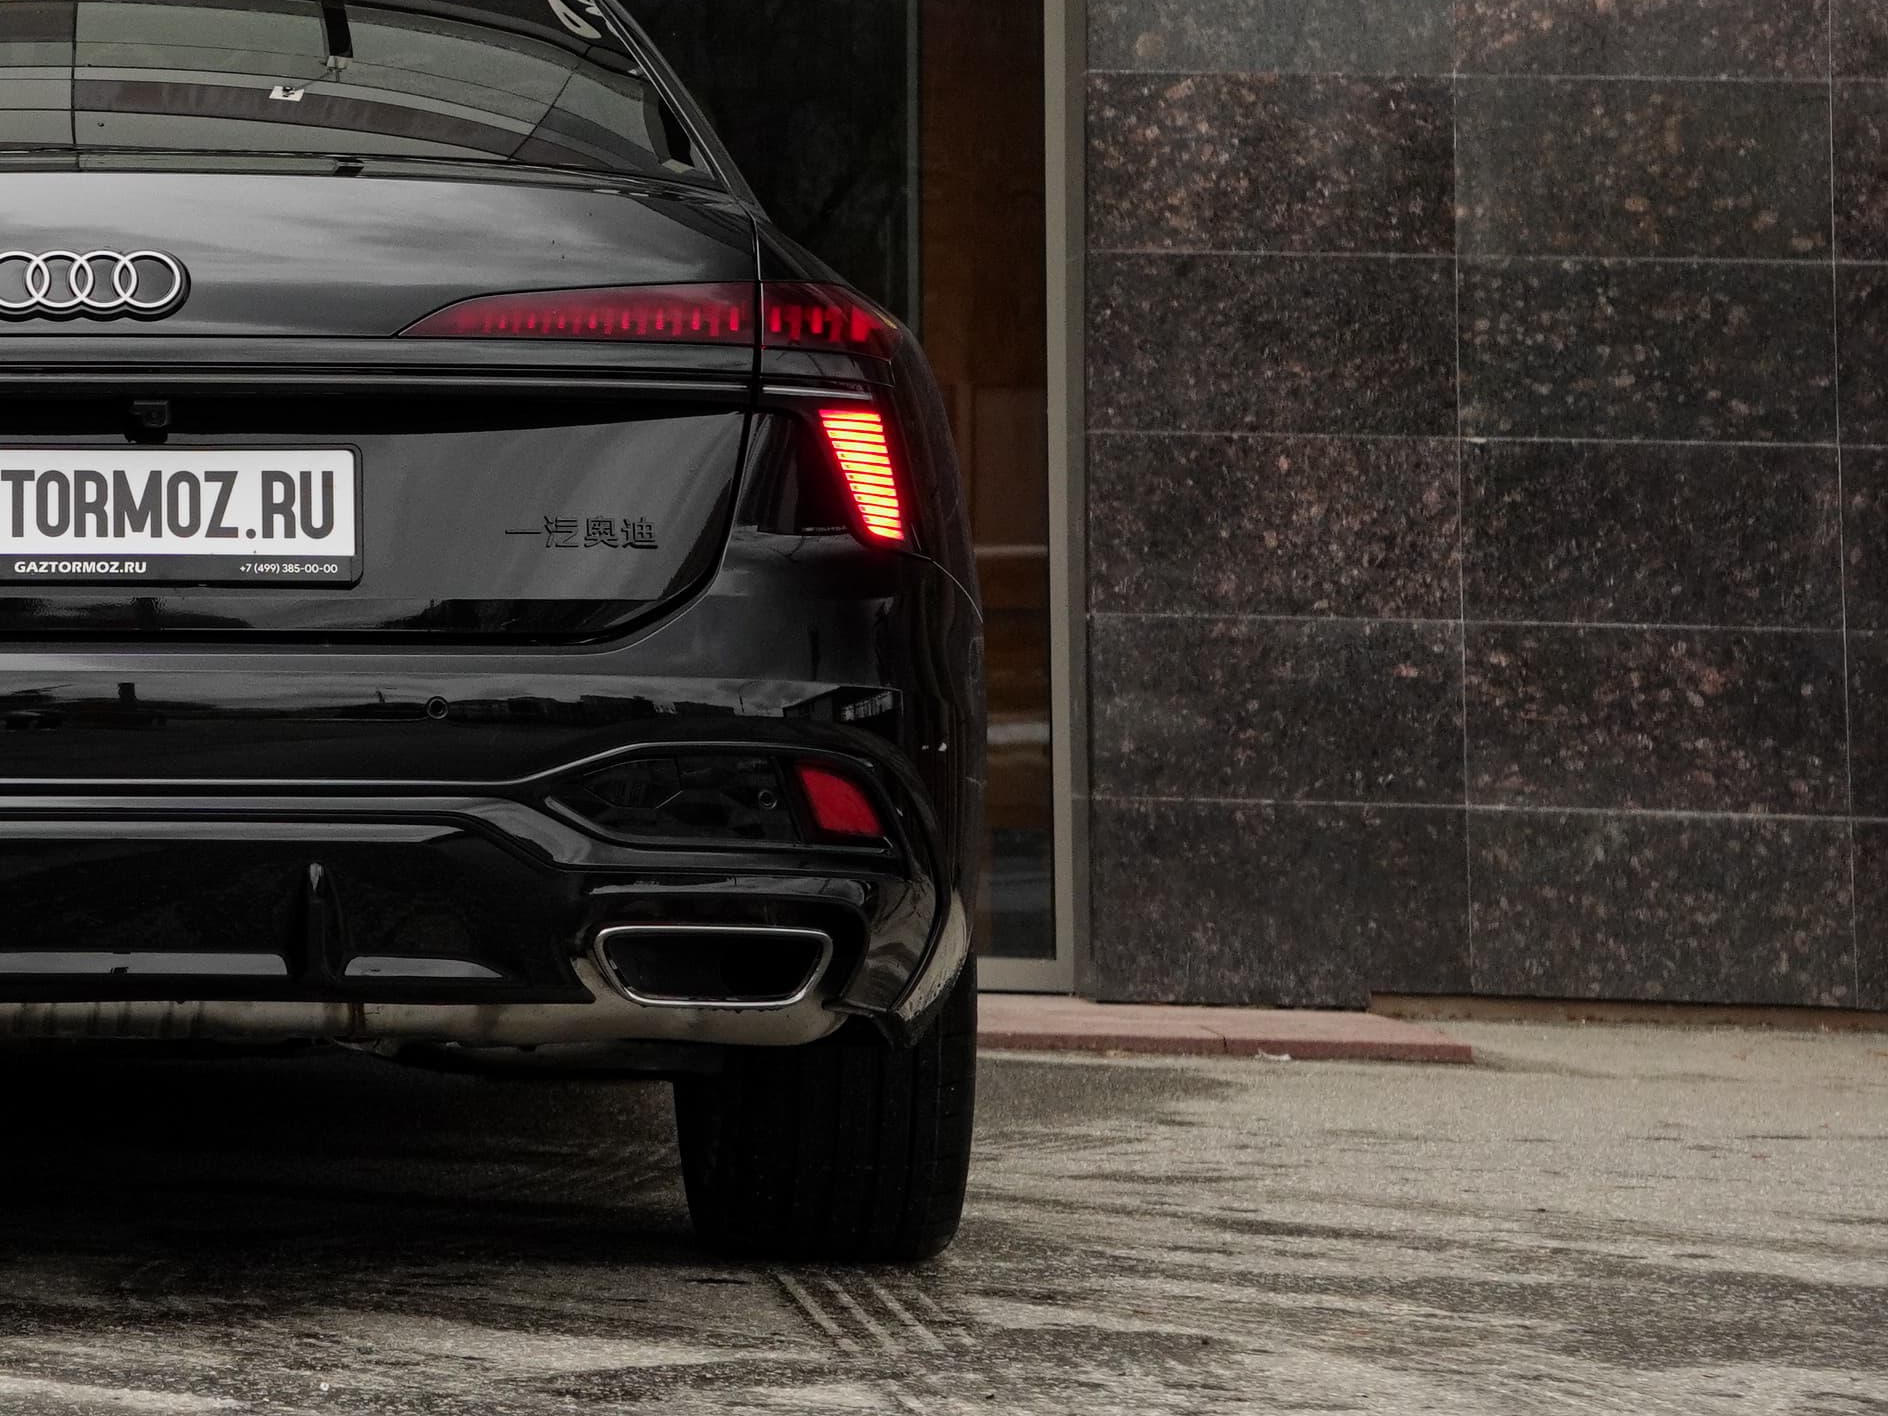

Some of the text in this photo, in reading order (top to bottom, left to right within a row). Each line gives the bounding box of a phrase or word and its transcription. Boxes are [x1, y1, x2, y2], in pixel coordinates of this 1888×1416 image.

[504, 515, 659, 550] 一汽奥迪
[14, 561, 147, 573] GAZTORMOZ.RU
[239, 563, 339, 574] +7 (499) 385-00-00
